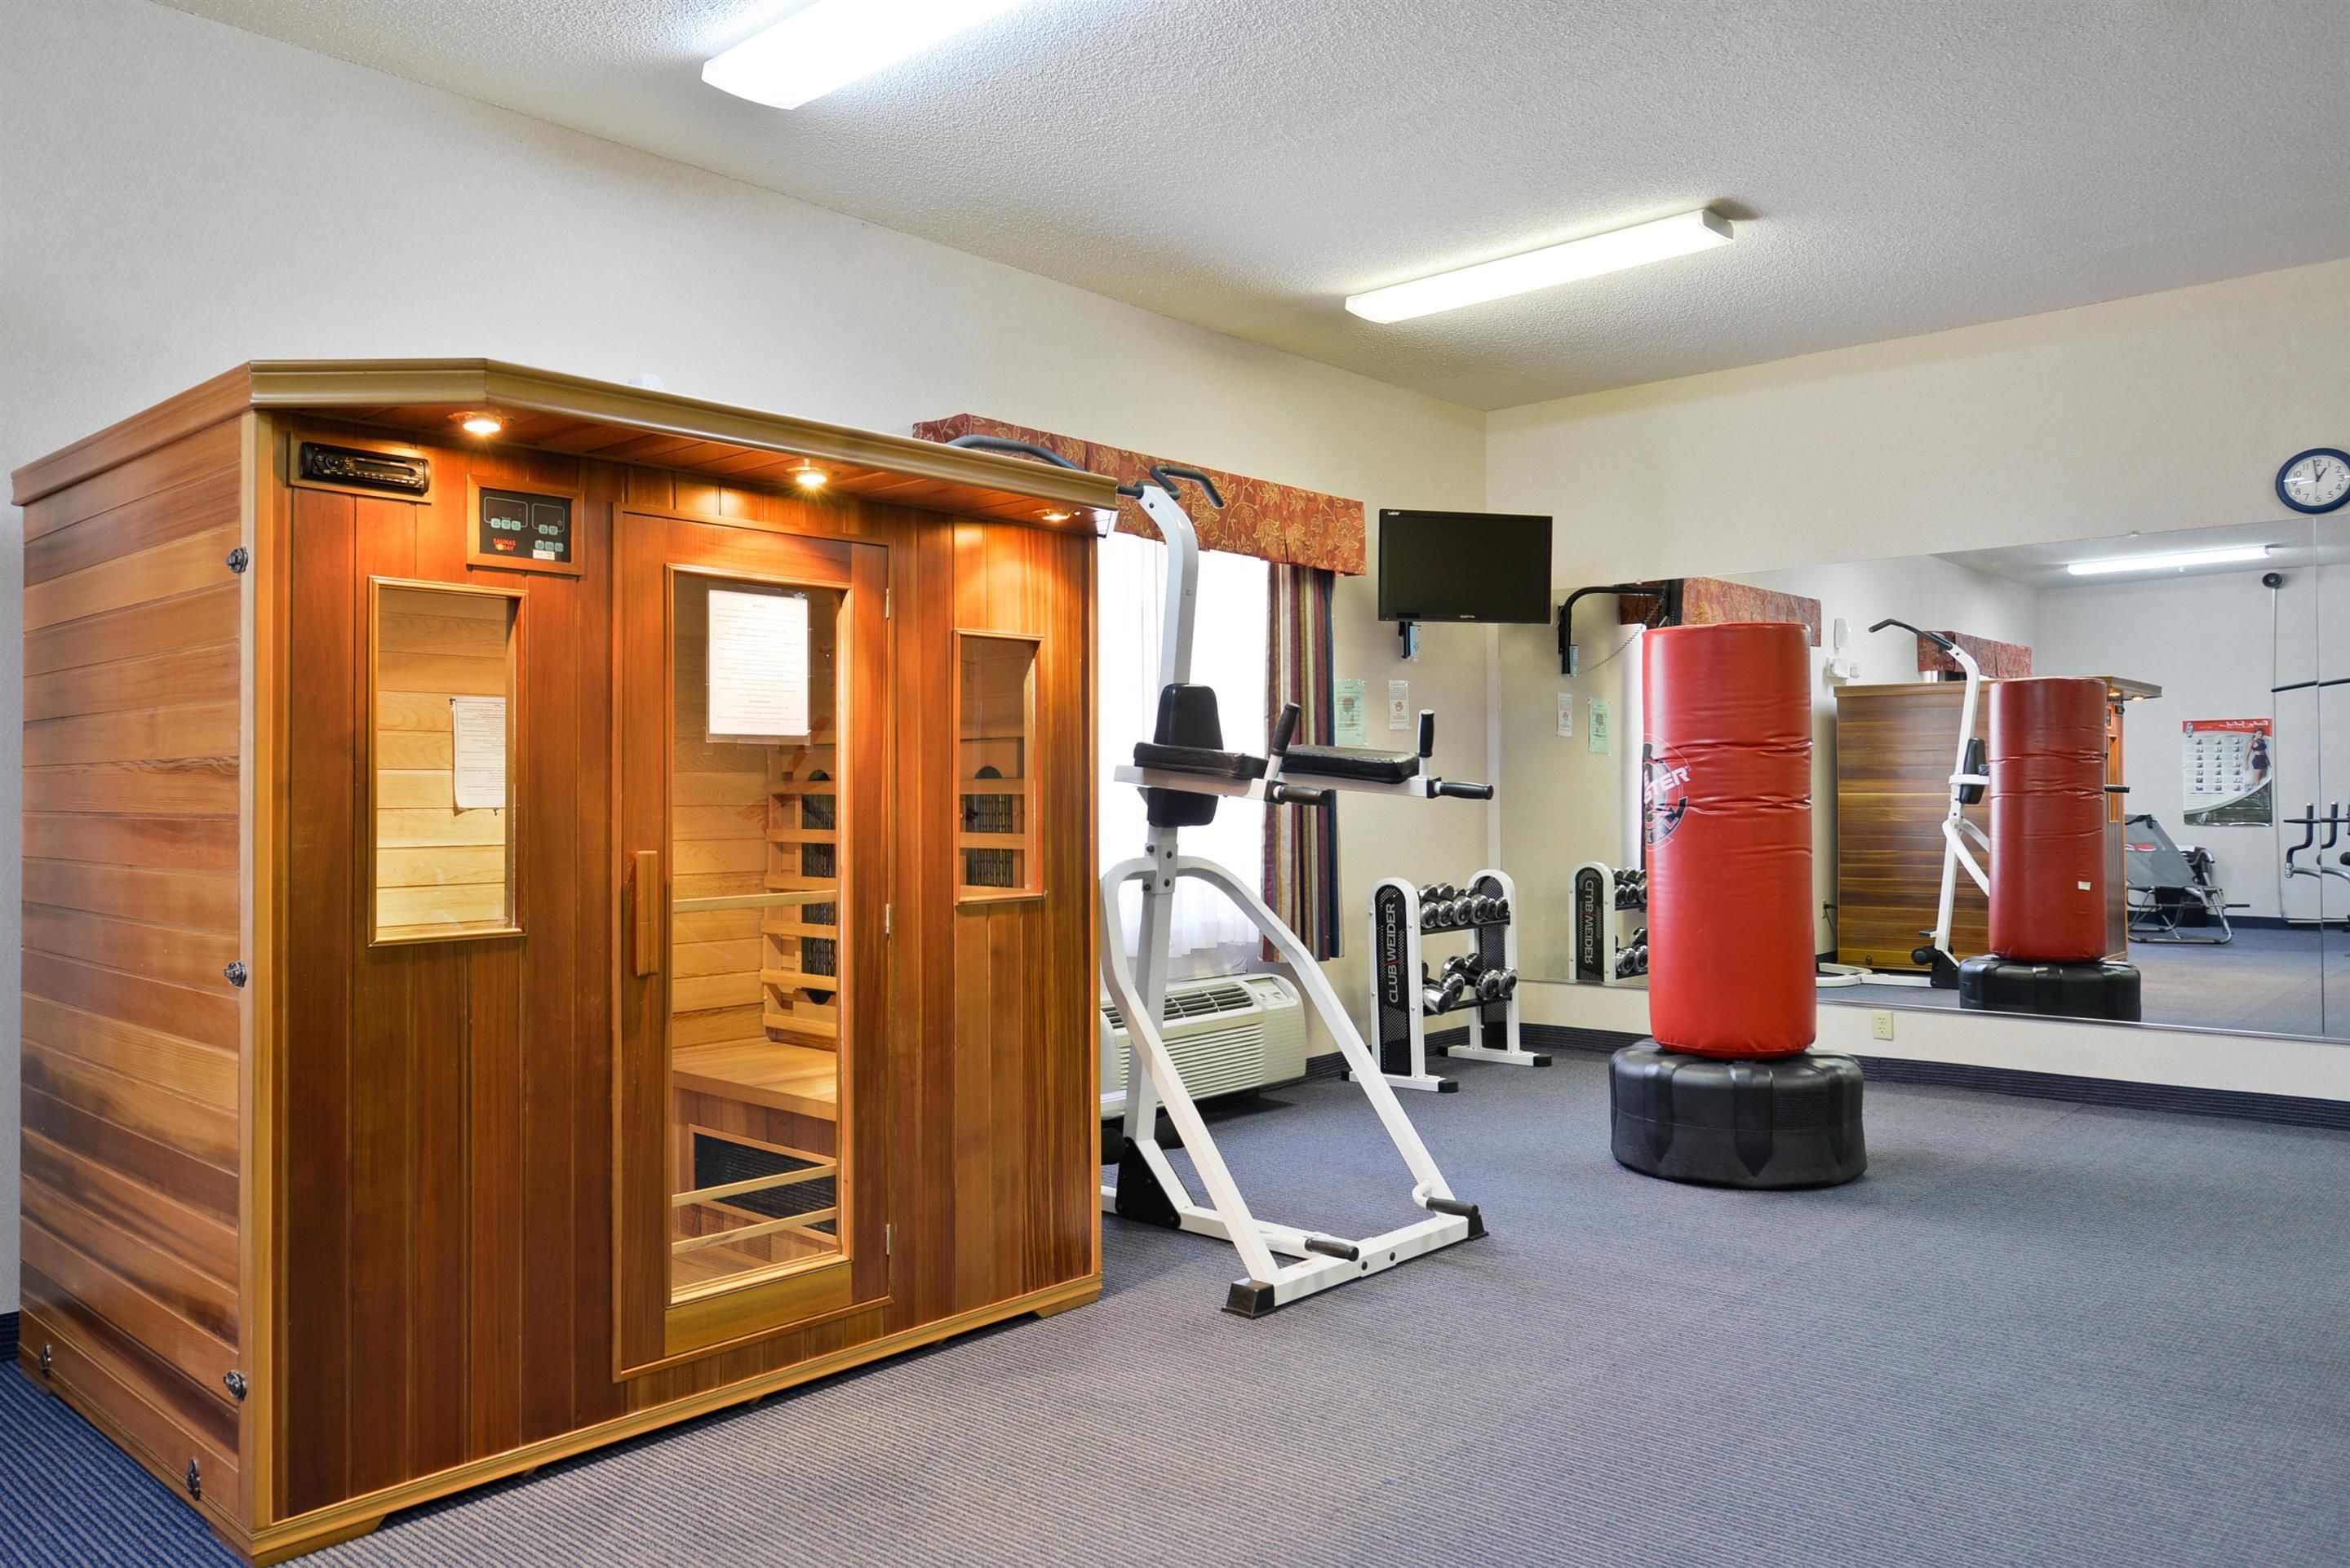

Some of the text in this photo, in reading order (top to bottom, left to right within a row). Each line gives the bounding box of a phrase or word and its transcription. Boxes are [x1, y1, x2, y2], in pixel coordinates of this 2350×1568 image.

[2303, 463, 2309, 471] 11
[2293, 470, 2302, 478] 10
[2339, 474, 2345, 482] 3
[2303, 493, 2310, 501] 7
[2327, 490, 2334, 498] 5
[2315, 494, 2321, 503] 6
[1386, 903, 1399, 1003] CLUB WEIDER
